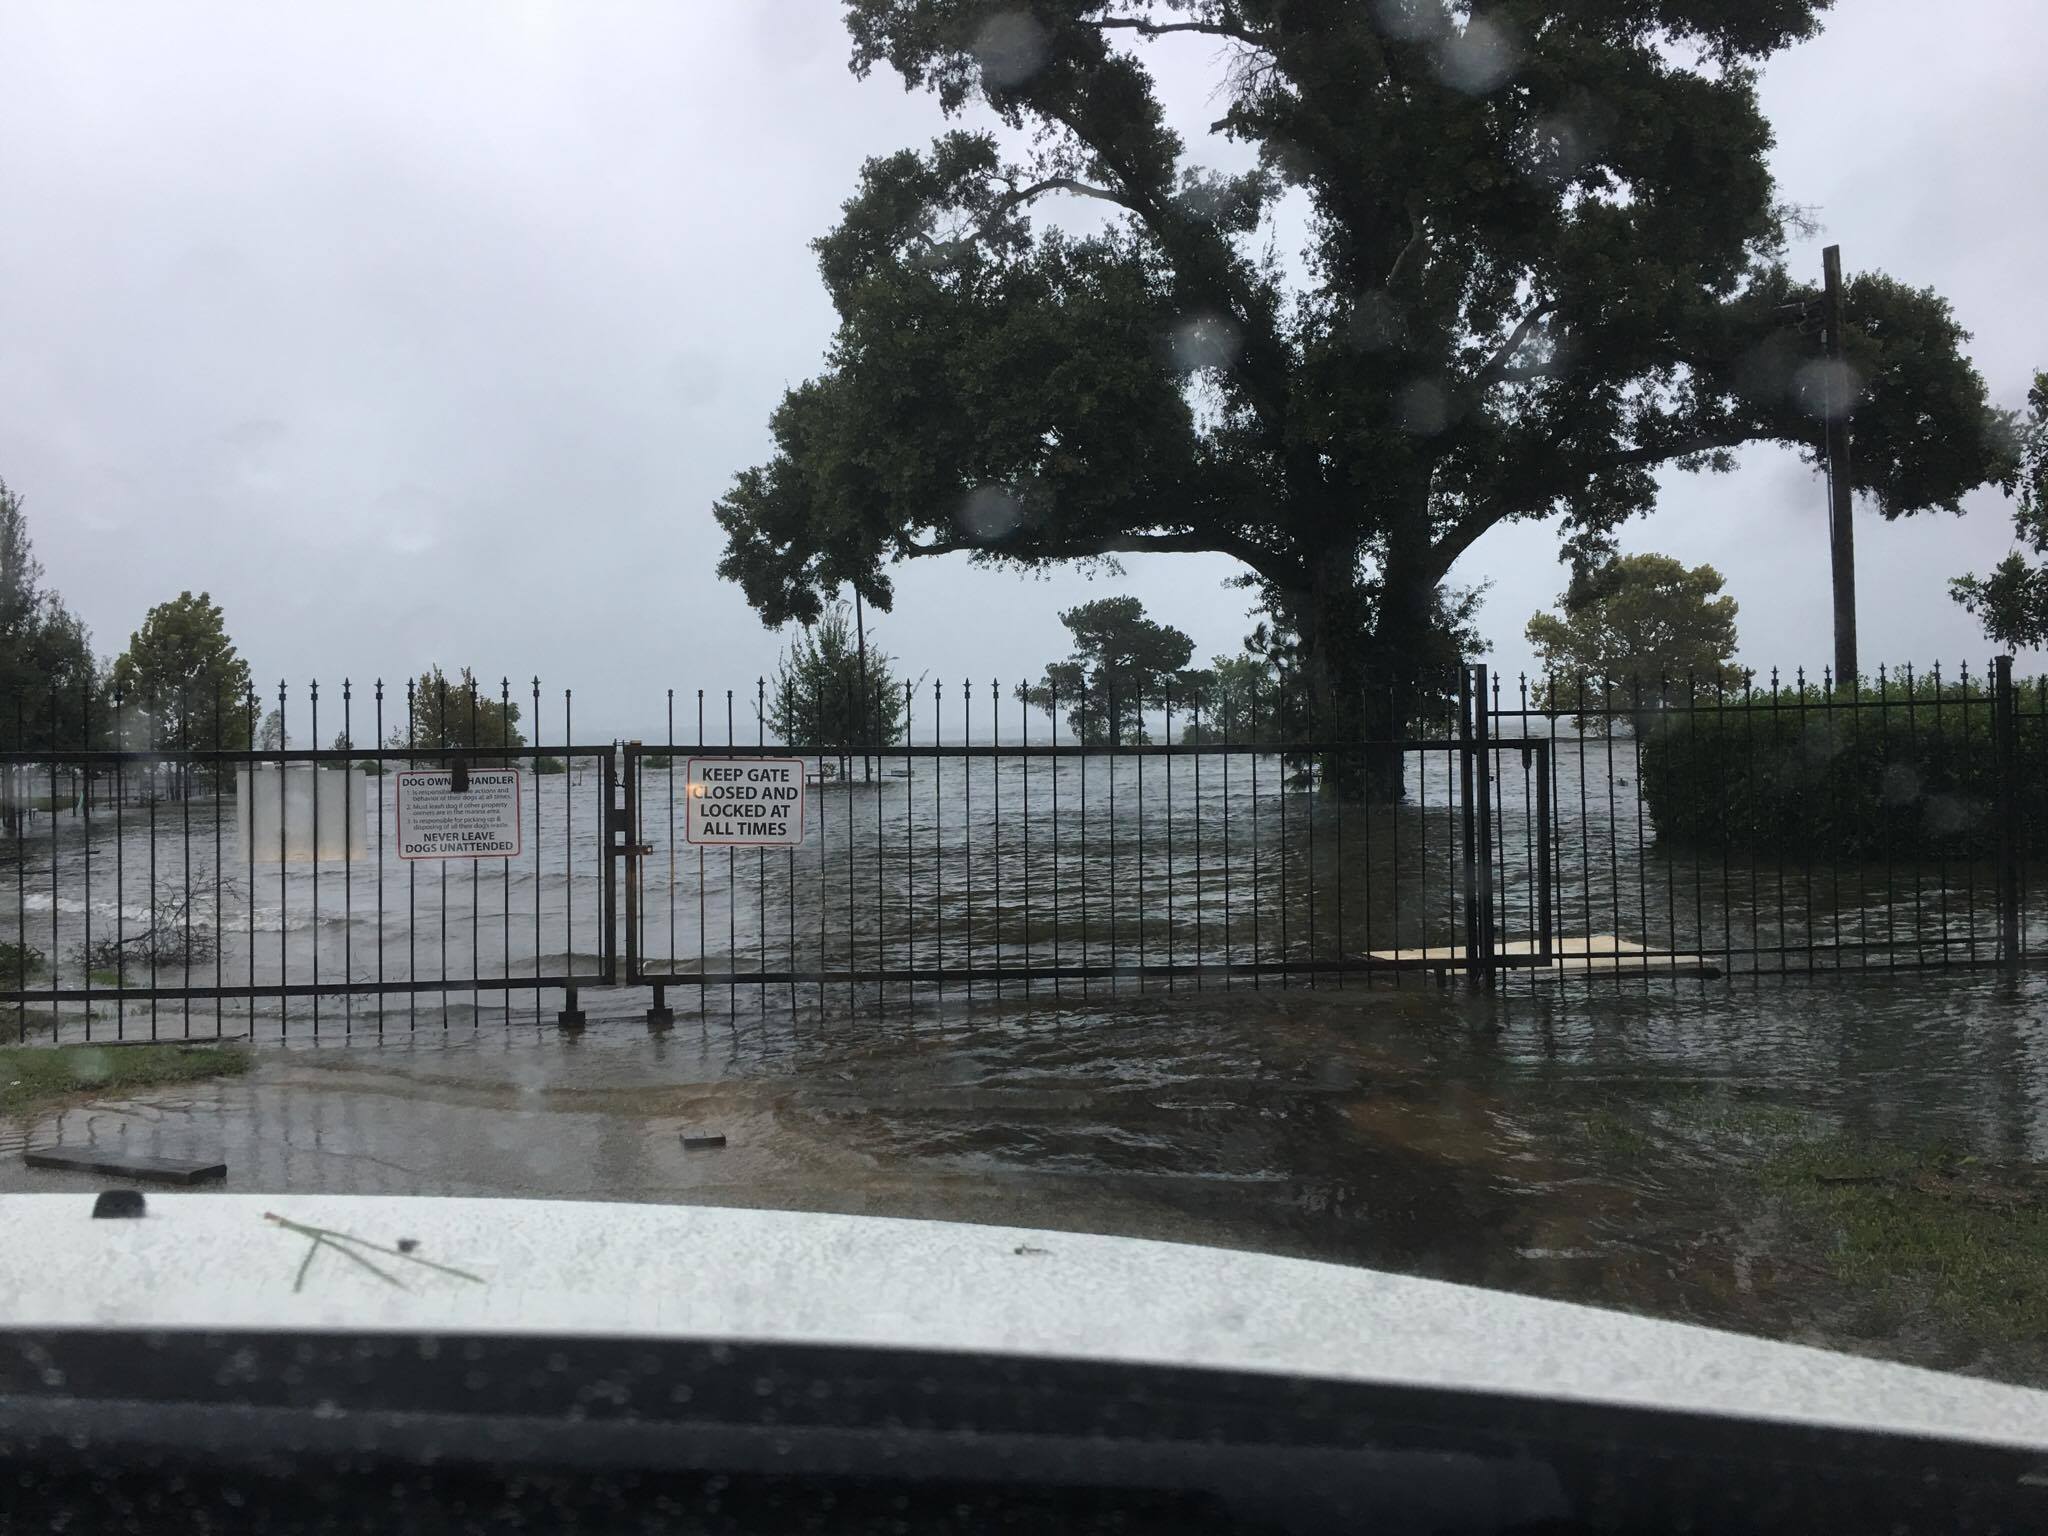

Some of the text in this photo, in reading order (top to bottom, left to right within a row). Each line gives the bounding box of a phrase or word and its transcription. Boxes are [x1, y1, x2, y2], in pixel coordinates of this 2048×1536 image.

[403, 778, 425, 786] DOG
[467, 776, 514, 785] HANDLER
[703, 768, 789, 782] KEEP GATE
[693, 786, 798, 800] CLOSED AND
[700, 804, 790, 818] LOCKED AT
[703, 822, 787, 836] ALL TIMES
[424, 832, 495, 842] NEVER LEAVE
[405, 841, 513, 853] DOGS UNATTENDED
